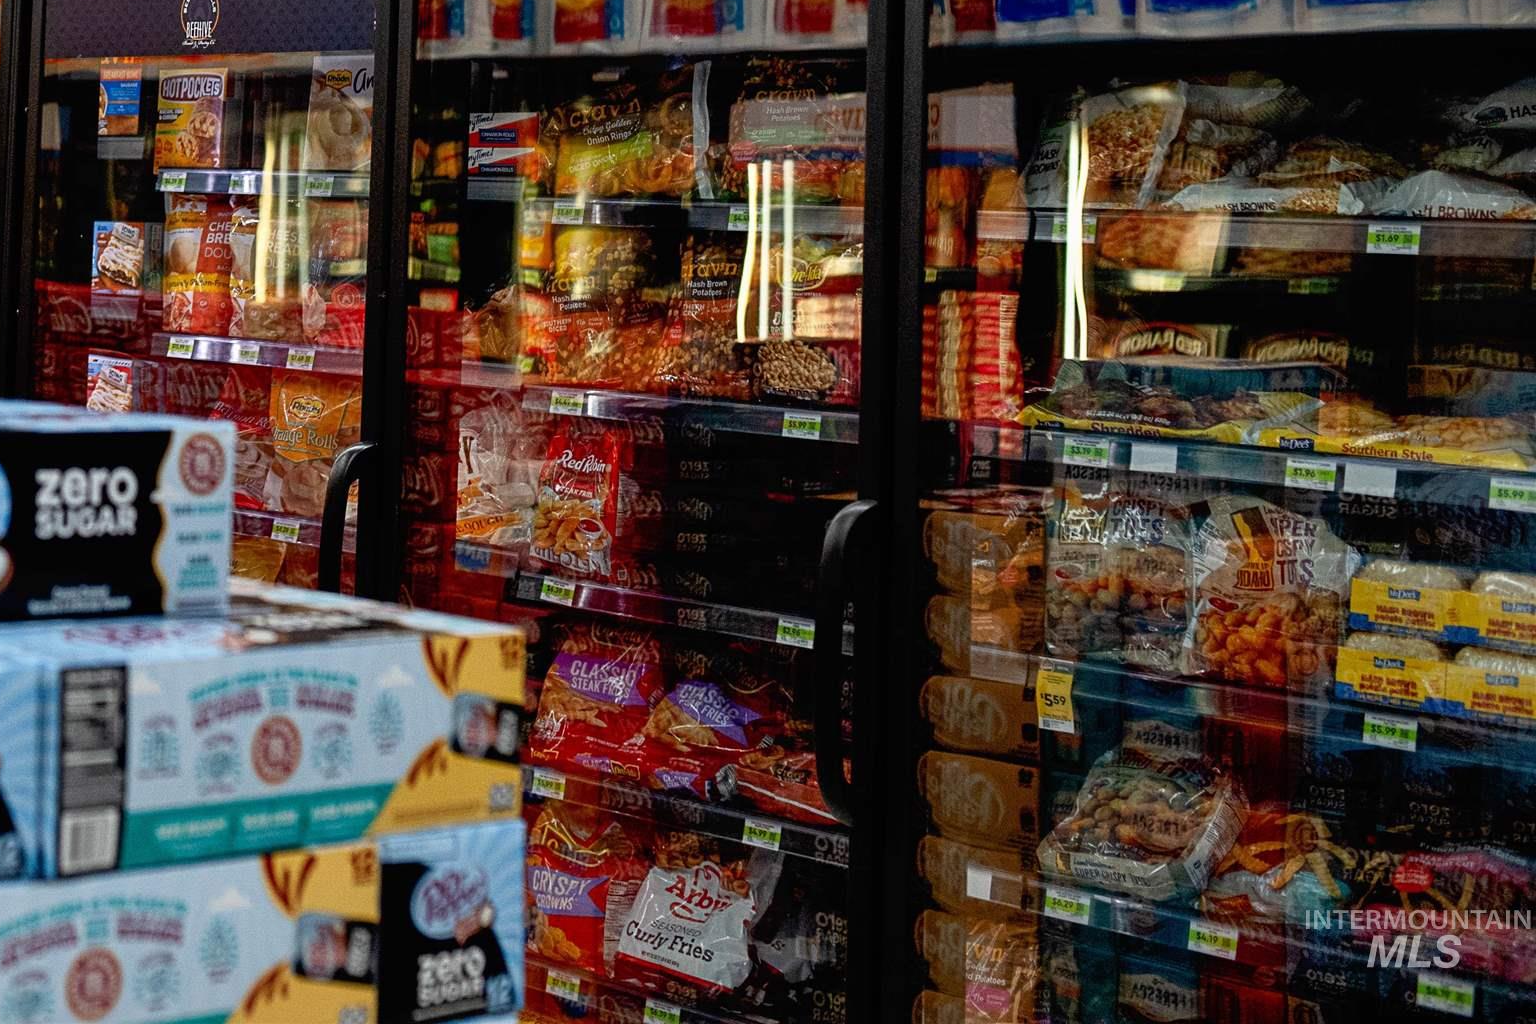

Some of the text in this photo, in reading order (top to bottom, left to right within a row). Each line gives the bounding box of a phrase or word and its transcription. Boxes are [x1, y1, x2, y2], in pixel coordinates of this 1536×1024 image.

[186, 21, 212, 38] BEEHIVE
[586, 129, 632, 146] Onion Rings
[1375, 234, 1400, 243] $1.69
[686, 279, 728, 289] Hash Brown
[691, 288, 723, 297] Potatoes
[307, 430, 340, 449] Rolls
[1341, 442, 1434, 462] Southern Style
[556, 449, 607, 474] Red Robin
[35, 467, 140, 506] zero
[1497, 489, 1525, 500] $5.99
[34, 505, 137, 540] SUGAR
[570, 659, 637, 687] CLASSIC
[571, 678, 601, 693] STEAK
[680, 684, 739, 716] CLASSIC
[700, 705, 730, 726] FRIES
[1370, 723, 1397, 734] $5.99
[535, 893, 574, 910] CROWNS
[650, 918, 703, 938] SEASONED
[626, 920, 715, 962] Curly Fries
[1196, 931, 1219, 944] $4.19
